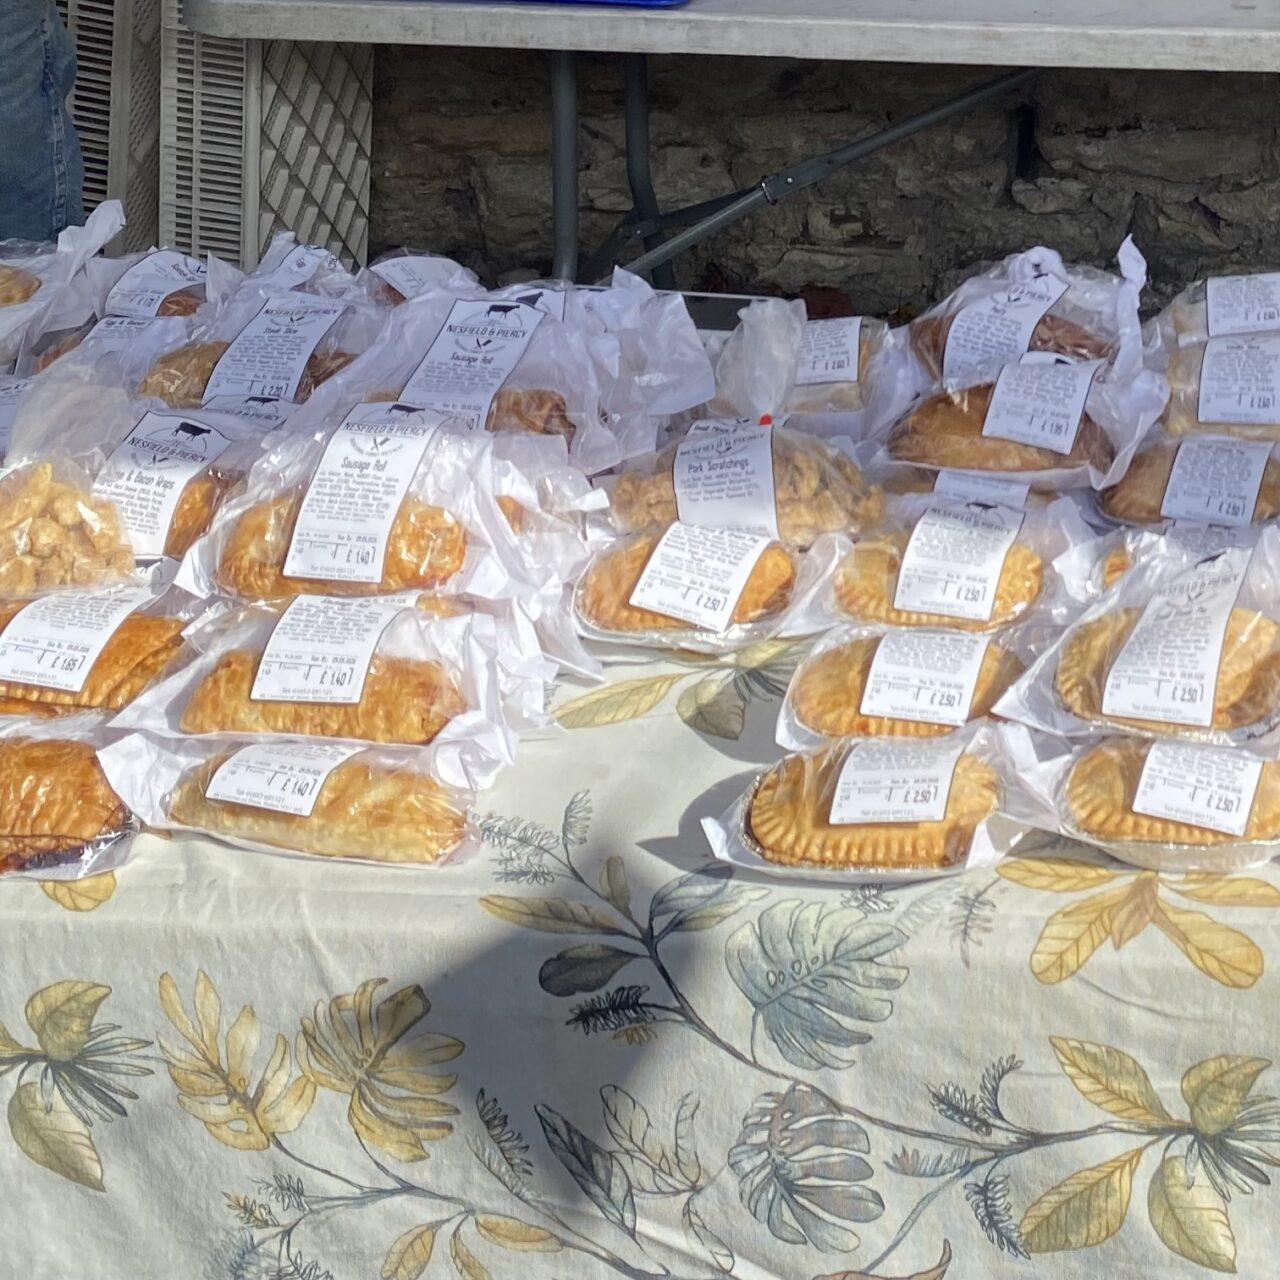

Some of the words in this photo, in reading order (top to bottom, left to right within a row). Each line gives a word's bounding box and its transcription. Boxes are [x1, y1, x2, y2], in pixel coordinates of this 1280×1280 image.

[447, 324, 487, 336] NESFIELD
[496, 328, 528, 338] PIERCY
[128, 436, 168, 454] NESFIELD
[176, 450, 208, 464] PIERCY
[341, 457, 371, 472] Sausage
[373, 460, 388, 472] Roll
[356, 551, 371, 565] 1.40
[330, 672, 347, 687] 1.40
[1180, 686, 1198, 703] 2.50
